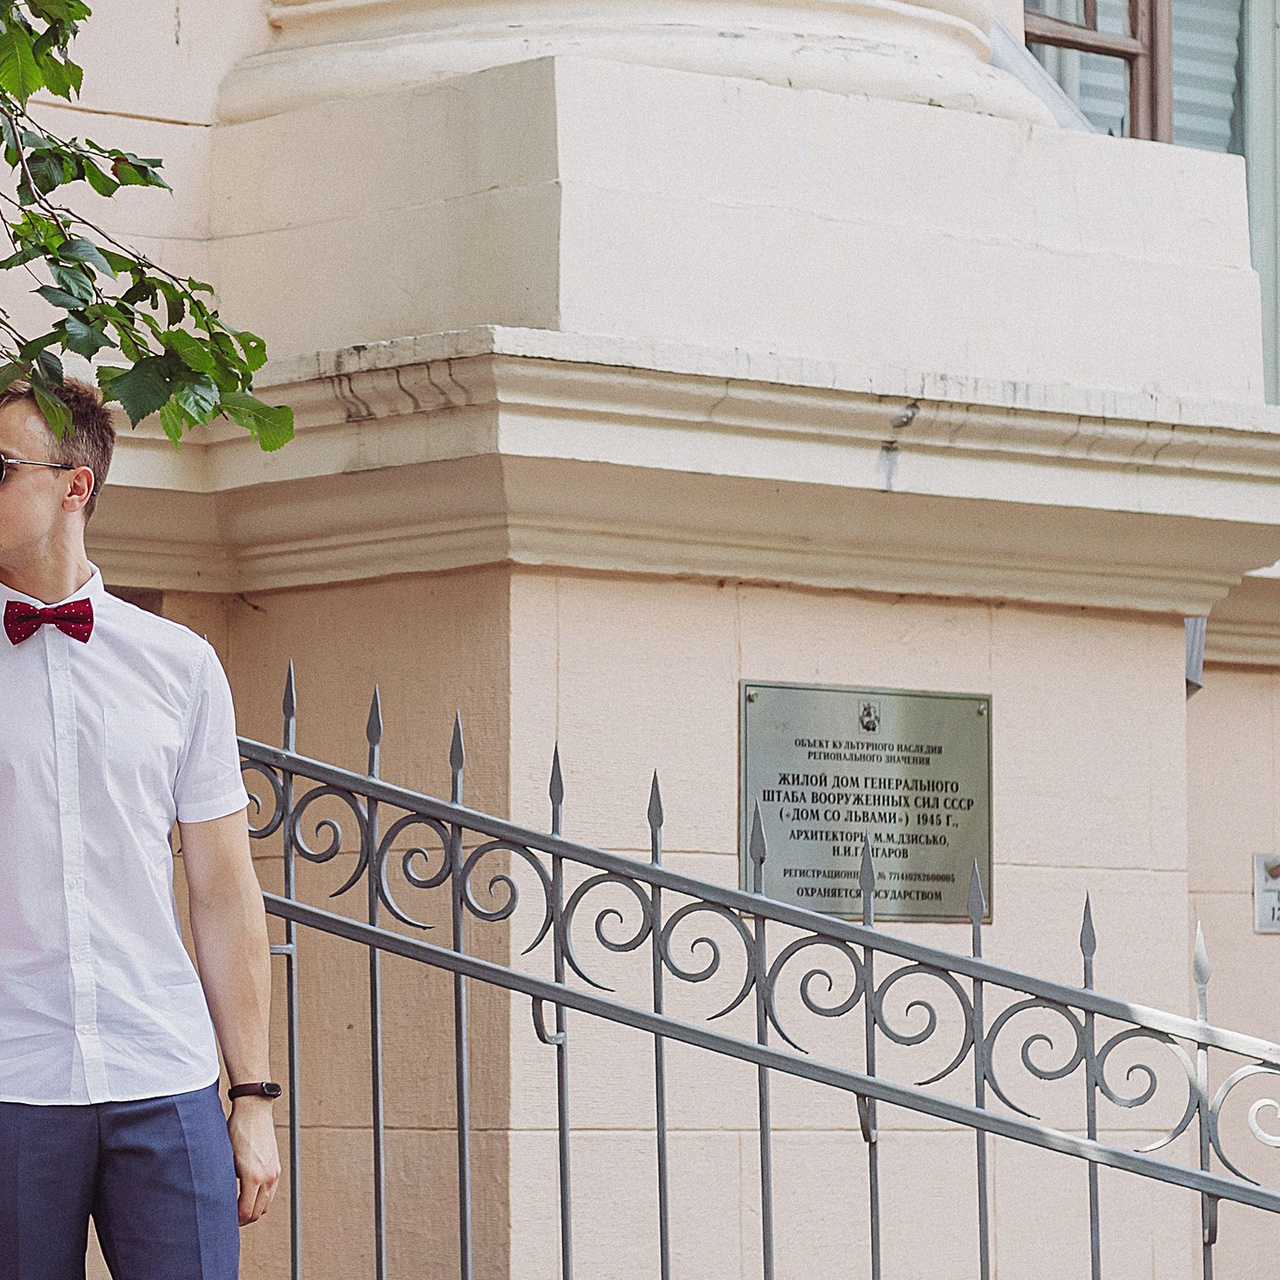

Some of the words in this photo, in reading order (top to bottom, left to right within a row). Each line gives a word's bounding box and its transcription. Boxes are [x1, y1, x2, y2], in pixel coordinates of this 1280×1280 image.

[794, 738, 829, 749] ОБЪЕКТ
[832, 740, 894, 752] КУЛЬТУРНОГО
[896, 743, 943, 755] НАСЛЕДИЯ
[807, 751, 882, 763] РЕГИОНАЛЬНОГО
[885, 755, 931, 766] ЗНАЧЕНИЯ
[778, 772, 828, 787] ЖИЛОЙ
[831, 775, 860, 789] ДОМ
[863, 777, 960, 793] ГЕНЕРАЛЬНОГО
[762, 789, 807, 803] ШТАБА
[811, 791, 910, 808] ВООРУЖЕННЫХ
[914, 796, 940, 809] СИЛ
[943, 797, 975, 811] СССР
[823, 809, 841, 822] СО
[916, 813, 942, 827] 1945
[796, 886, 862, 899] ОХРАНЯЕТСЯ
[872, 888, 942, 901] ОСУДАРСТВОМ
